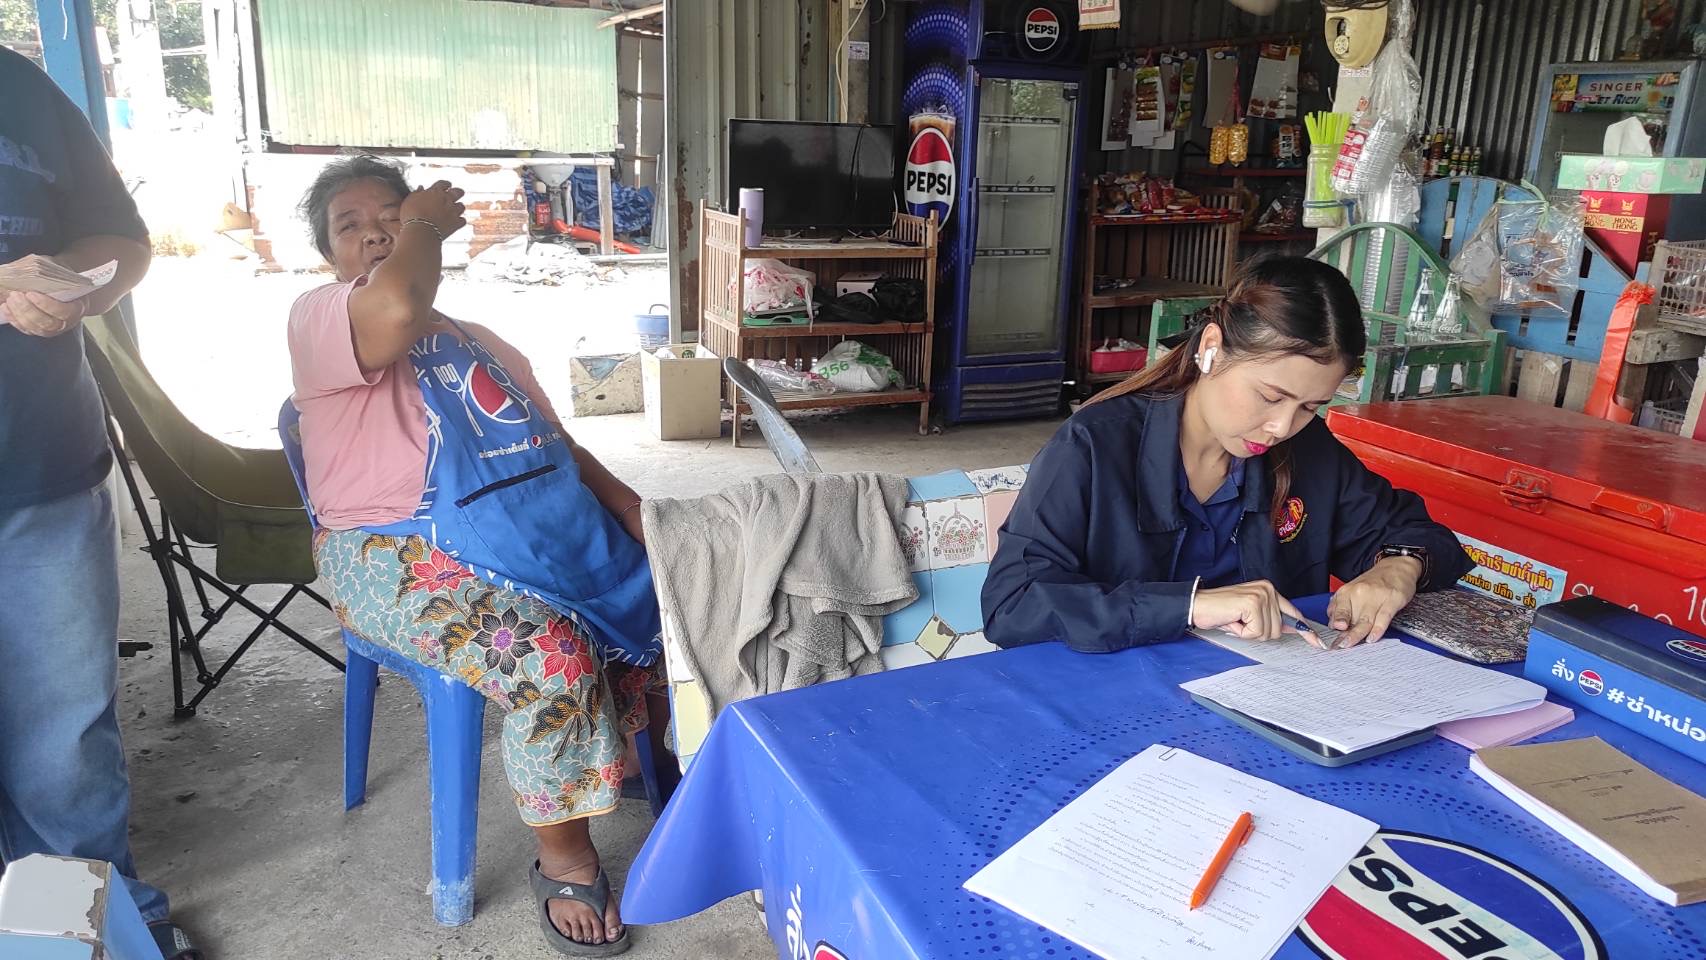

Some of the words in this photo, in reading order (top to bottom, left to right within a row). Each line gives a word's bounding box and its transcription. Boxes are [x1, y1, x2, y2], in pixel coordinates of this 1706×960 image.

[1027, 23, 1057, 36] PEPSI
[1589, 82, 1643, 92] SINGER
[1612, 93, 1641, 105] RICH
[907, 170, 952, 196] PEPSI
[1612, 222, 1638, 231] THONG
[1614, 217, 1637, 225] HONG
[1493, 581, 1513, 600] ปลีก
[1523, 592, 1537, 609] ส่ง
[1551, 658, 1575, 682] สั่ง
[1579, 676, 1603, 690] PEPSI
